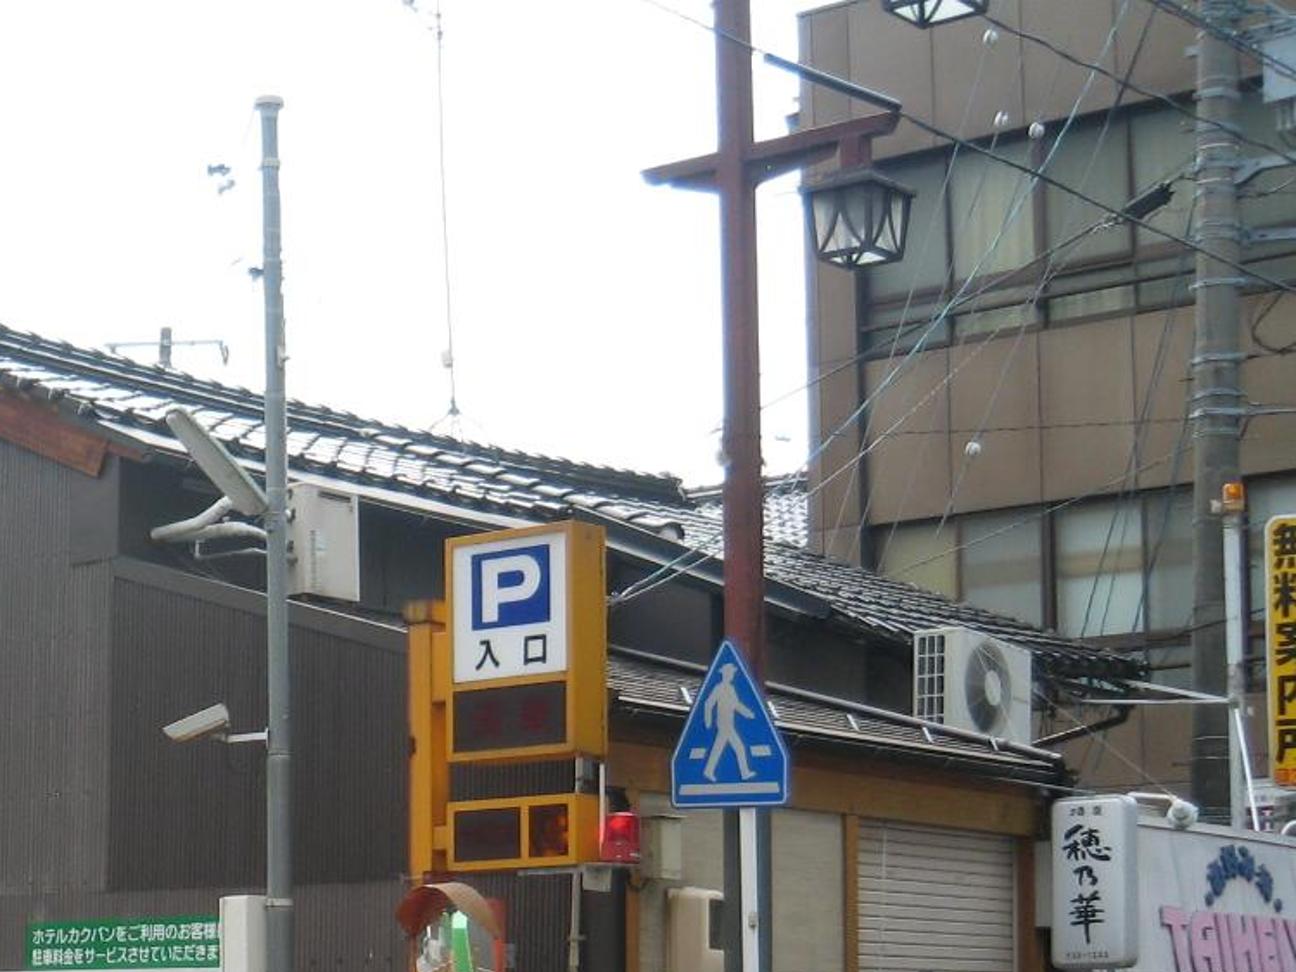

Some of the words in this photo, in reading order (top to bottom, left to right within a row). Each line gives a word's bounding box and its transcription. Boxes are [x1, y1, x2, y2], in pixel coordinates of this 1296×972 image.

[481, 554, 542, 624] P
[475, 634, 548, 671] 入口
[32, 921, 222, 945] ホテルカクバンをご利用のお客様
